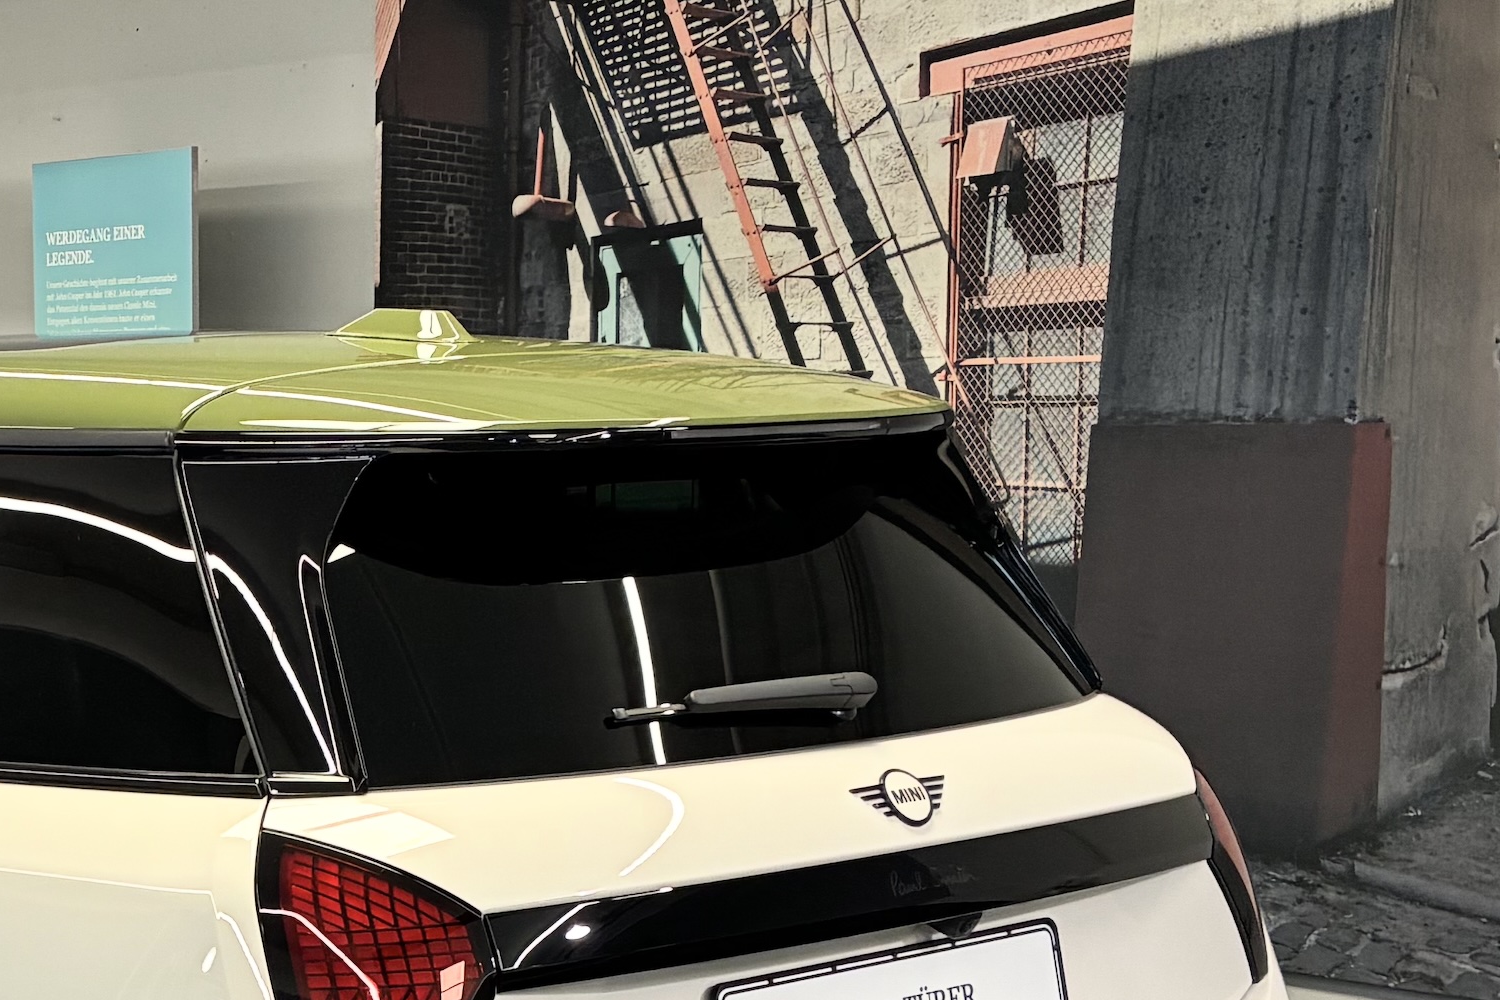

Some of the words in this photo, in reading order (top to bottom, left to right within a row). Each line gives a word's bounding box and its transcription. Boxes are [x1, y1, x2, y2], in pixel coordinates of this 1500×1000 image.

[46, 227, 111, 246] WERDEGANG
[113, 224, 146, 241] EINER
[46, 250, 95, 267] LEGENDE.
[891, 786, 926, 805] MINI
